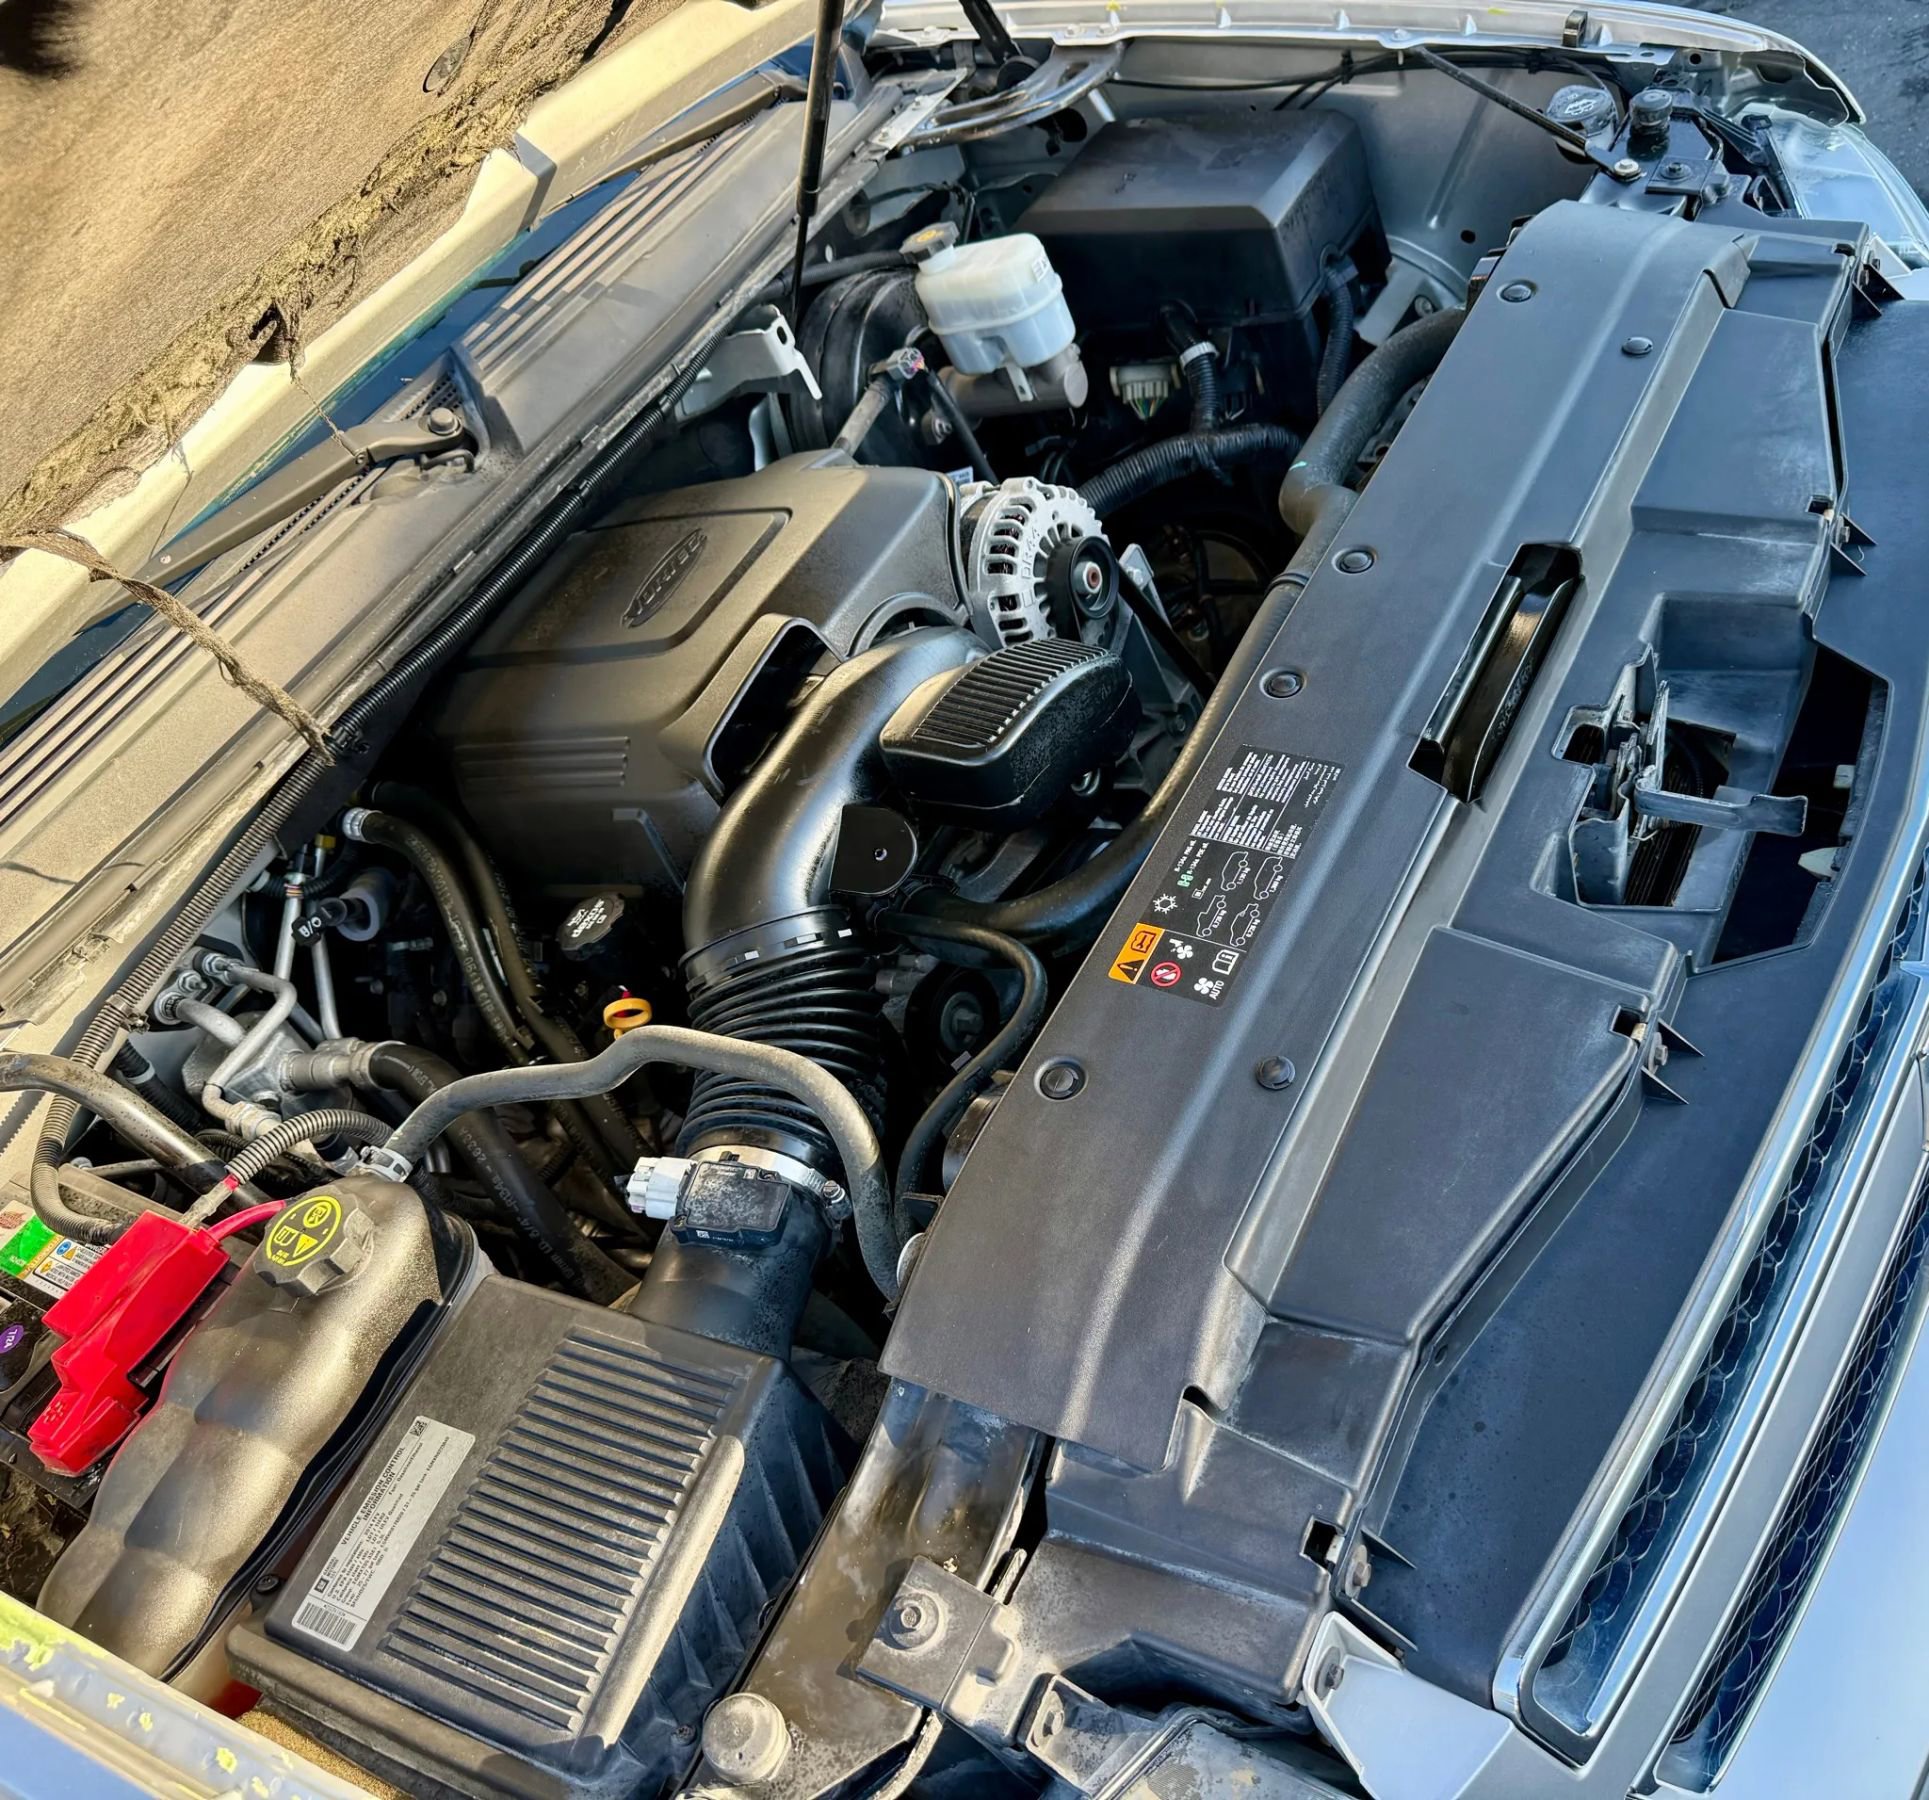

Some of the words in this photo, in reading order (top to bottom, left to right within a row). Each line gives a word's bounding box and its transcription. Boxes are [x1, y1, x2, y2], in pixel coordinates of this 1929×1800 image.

[1209, 979, 1225, 999] AUTO
[340, 1514, 362, 1546] VEHICLE
[360, 1479, 384, 1514] EMISSION
[382, 1445, 405, 1479] CONTROL
[362, 1470, 396, 1521] INFORMATION
